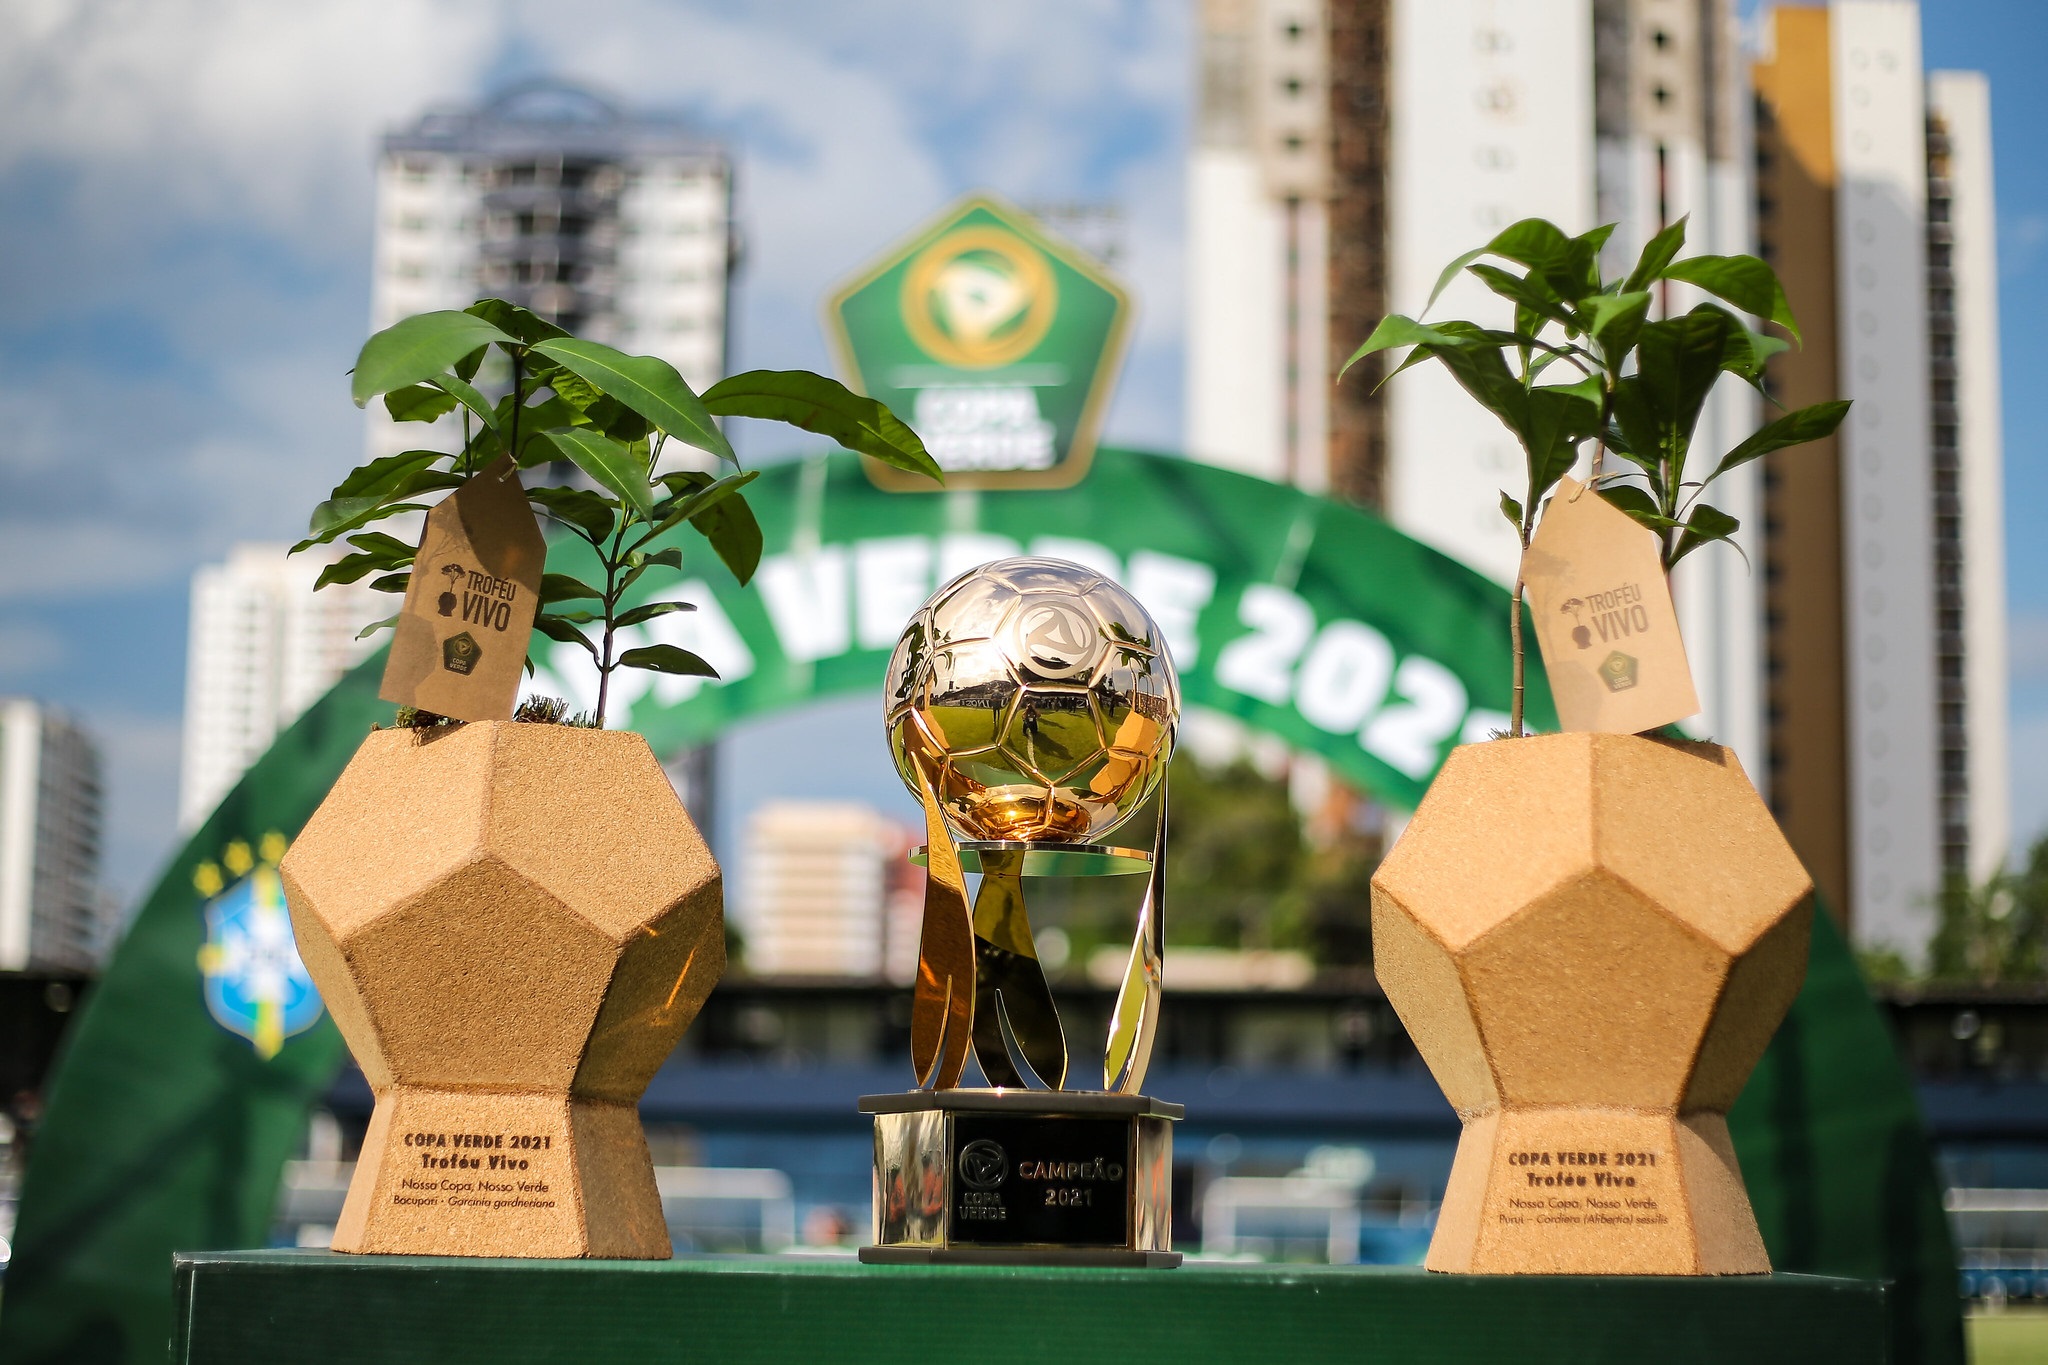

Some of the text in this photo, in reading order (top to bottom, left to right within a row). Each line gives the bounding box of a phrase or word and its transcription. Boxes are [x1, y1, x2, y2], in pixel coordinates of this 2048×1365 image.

[467, 570, 517, 602] TROFÉU
[1585, 582, 1642, 614] TROFÉU
[462, 591, 511, 632] VIVO
[1591, 604, 1649, 643] VIVO
[452, 657, 467, 666] COPA
[404, 1133, 551, 1150] COPA VERDE 2021
[488, 1154, 529, 1171] Vivo
[1508, 1152, 1657, 1168] COPA VERDE 2021
[1019, 1157, 1123, 1181] CAMPEÃO
[402, 1179, 438, 1191] Nossa
[478, 1180, 514, 1192] Nosso
[517, 1180, 549, 1193] Verde
[1594, 1171, 1636, 1187] Vivo
[448, 1196, 491, 1207] Garcinia
[963, 1192, 1001, 1206] COPA
[1044, 1188, 1093, 1207] 2021
[1509, 1198, 1545, 1210] Nossa
[1586, 1198, 1621, 1210] Nosso
[1624, 1197, 1658, 1210] Verde
[959, 1206, 1007, 1220] VERDE
